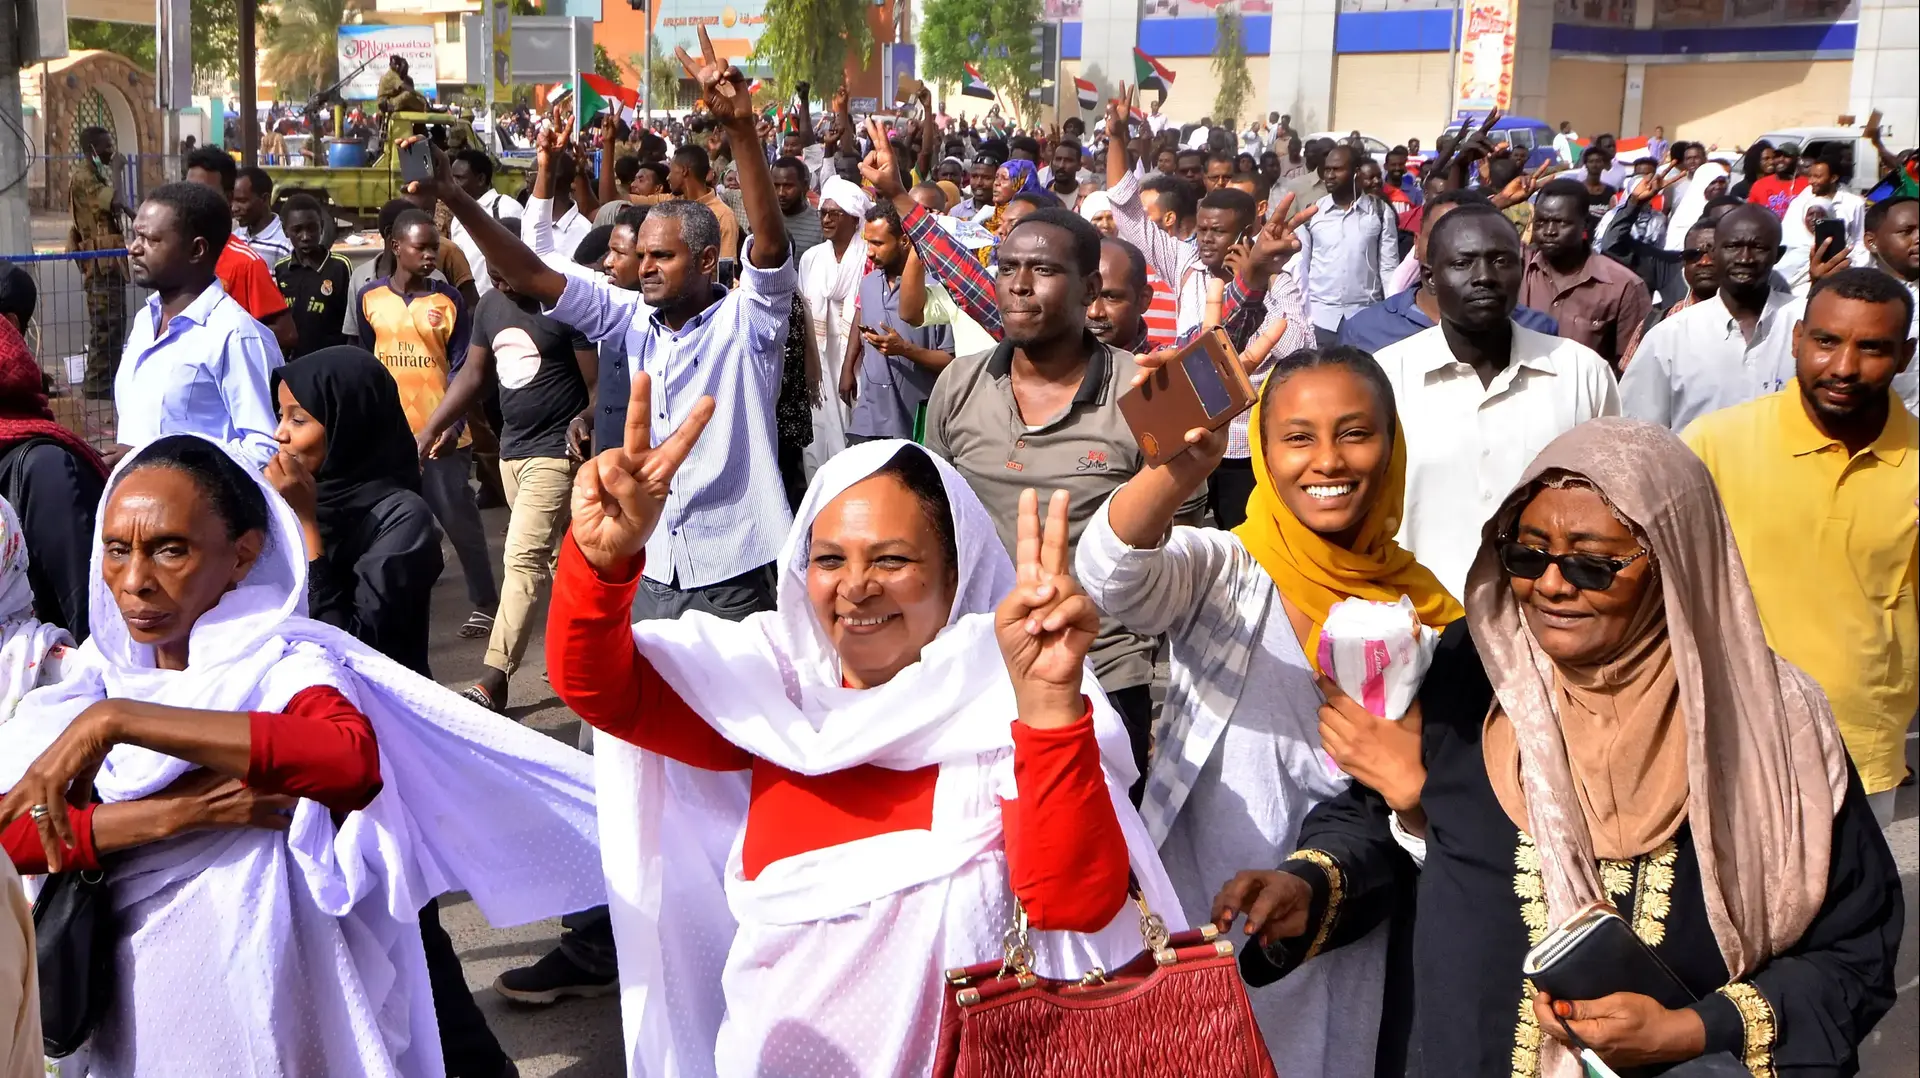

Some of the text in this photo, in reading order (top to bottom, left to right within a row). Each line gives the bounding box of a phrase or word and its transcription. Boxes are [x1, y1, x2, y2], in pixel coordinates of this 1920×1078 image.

[344, 40, 377, 59] JPN
[398, 341, 415, 353] Fly
[378, 352, 437, 369] Emirates
